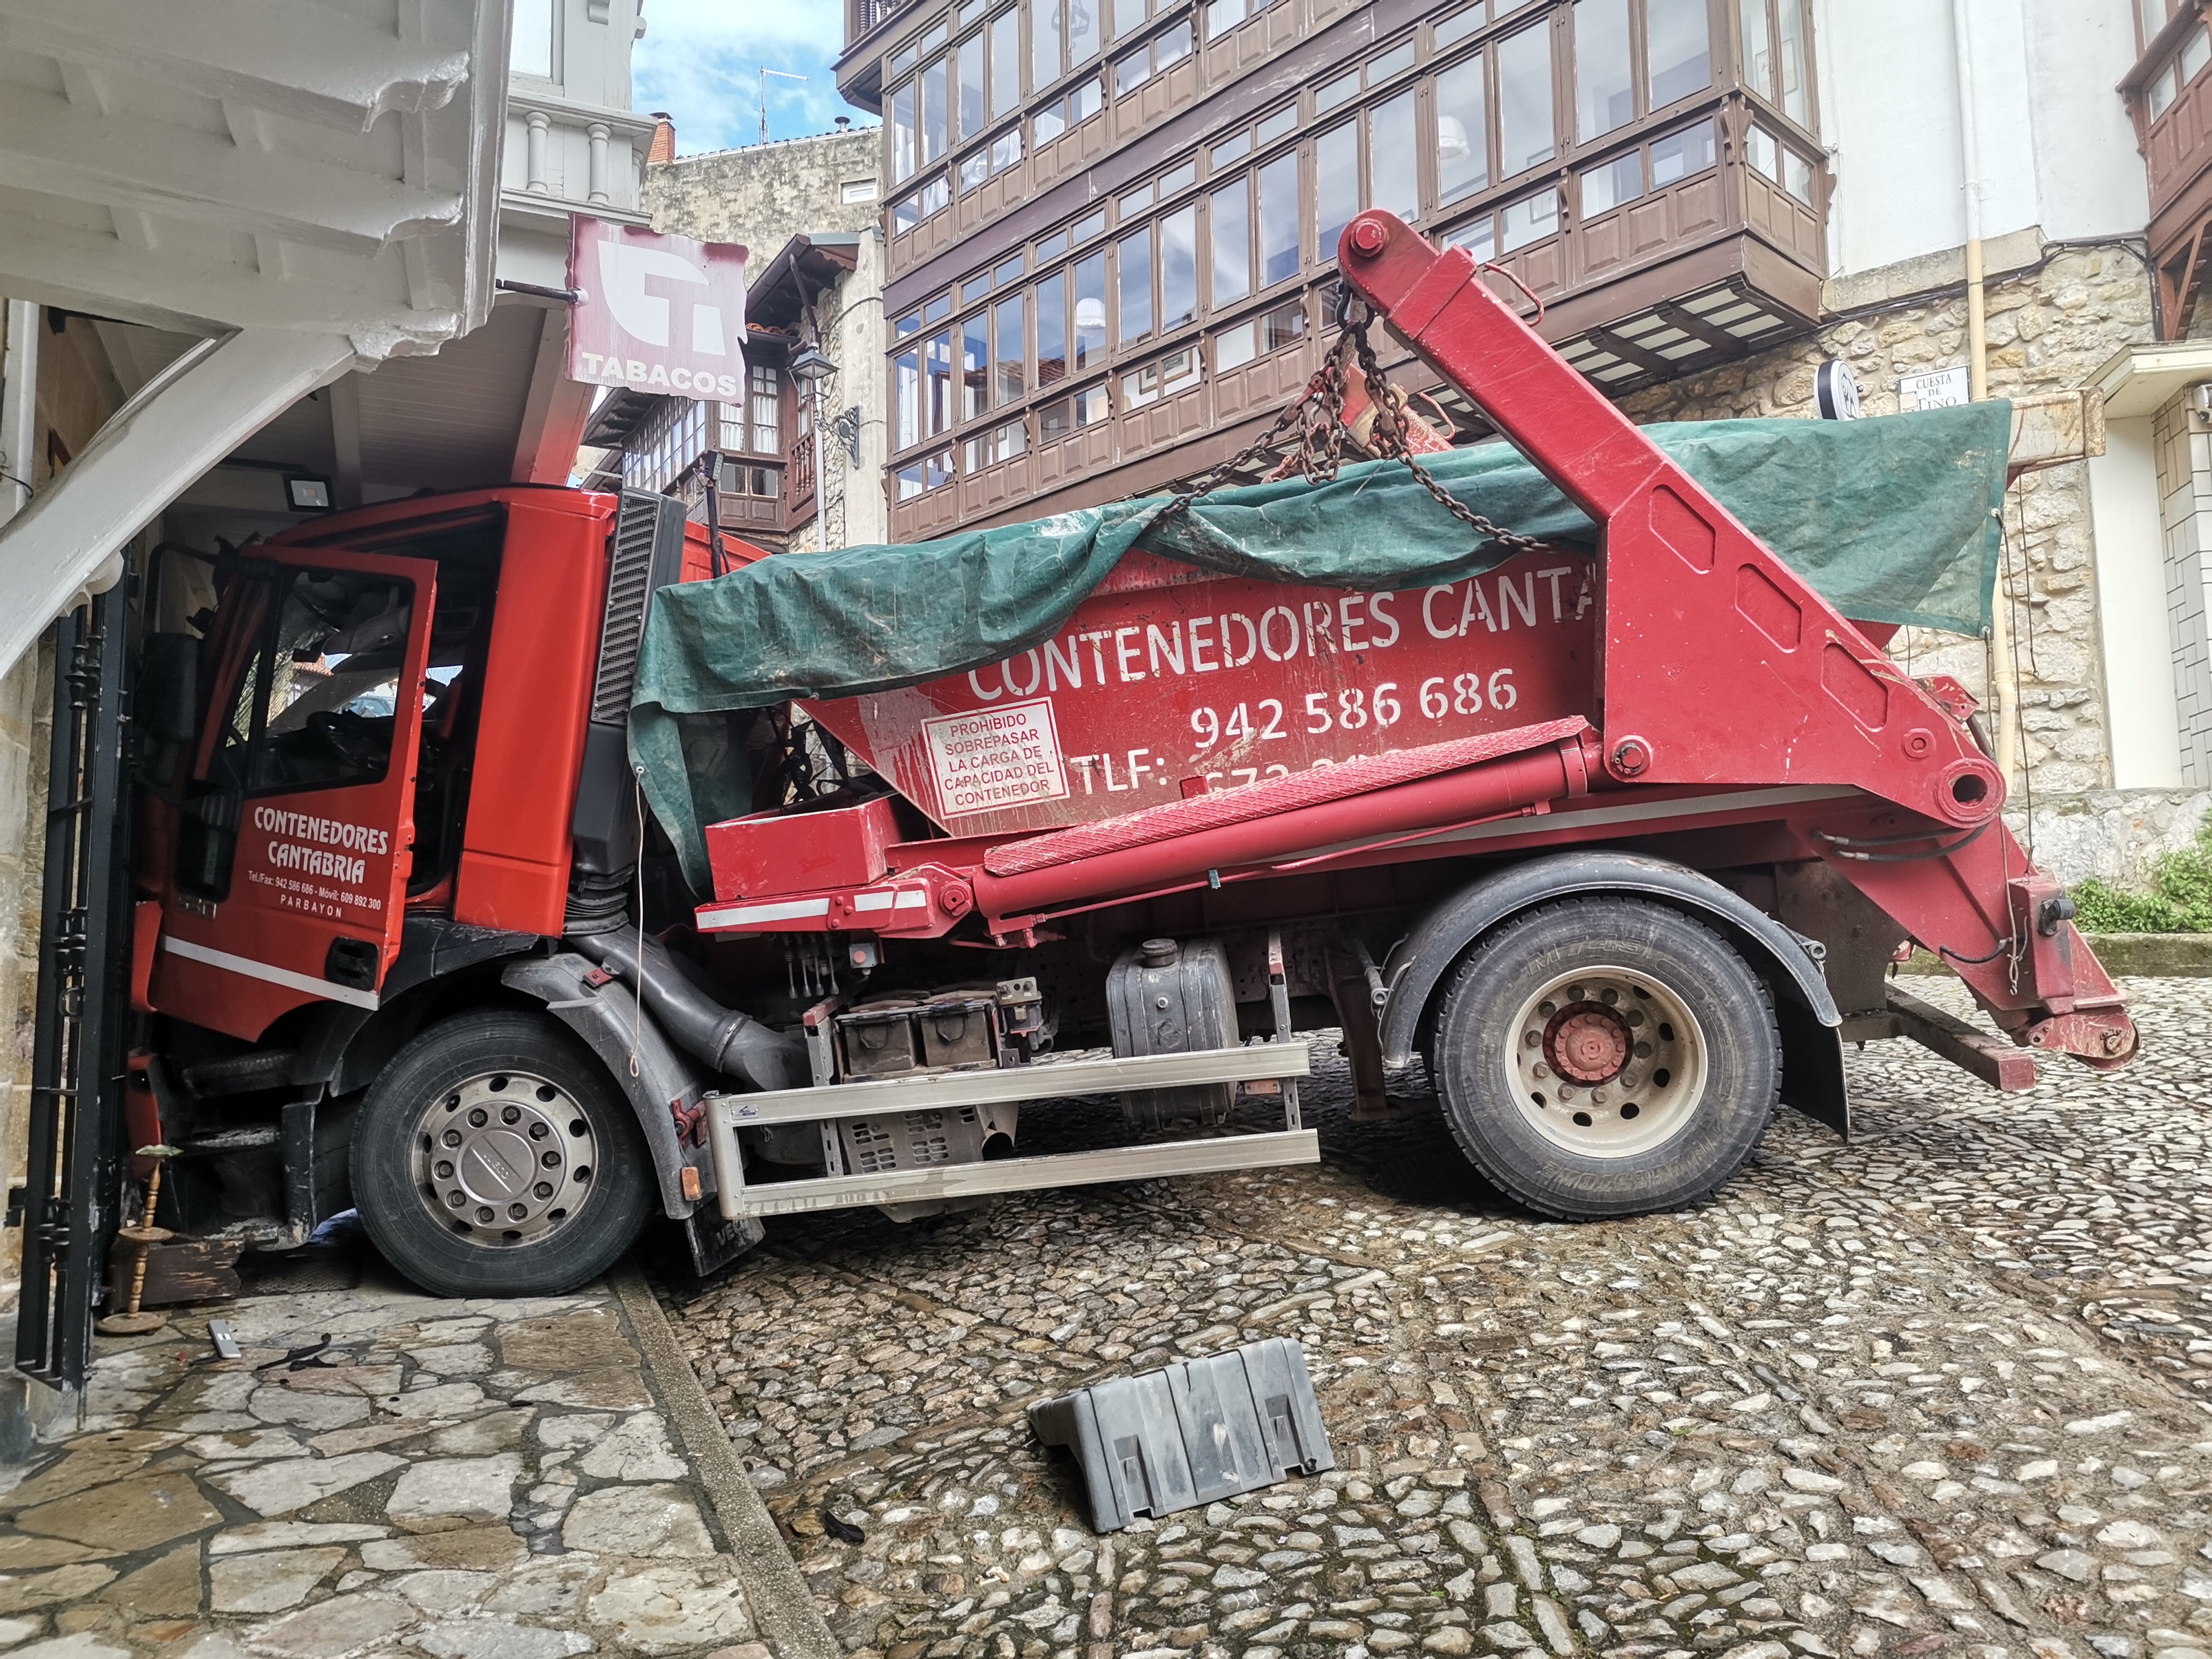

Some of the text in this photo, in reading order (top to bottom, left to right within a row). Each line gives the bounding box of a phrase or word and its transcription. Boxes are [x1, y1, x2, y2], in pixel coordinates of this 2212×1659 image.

[582, 352, 737, 397] TABACOS
[1916, 373, 1952, 389] CUESTA
[1928, 388, 1942, 397] DE
[968, 591, 1400, 701] CONTENEDORES
[1191, 668, 1517, 748] 942 586 686
[950, 713, 1027, 738] PROHIBIDO
[945, 728, 1040, 756] SOBREPASAR
[948, 745, 1043, 773] LA CARGA DE
[1070, 748, 1167, 795] TLF:
[944, 761, 1055, 791] CAPACIDAD DEL
[955, 779, 1051, 806] CONTENEDOR
[254, 806, 388, 855] CONTENEDORES
[268, 841, 366, 885] CANTABRIA
[275, 876, 288, 889] 942
[288, 879, 301, 892] 586
[301, 883, 314, 895] 686
[319, 886, 339, 901] Móvil:
[341, 891, 354, 904] 609
[354, 895, 368, 907] 892
[368, 898, 382, 911] 300
[280, 894, 342, 919] PARBAYON
